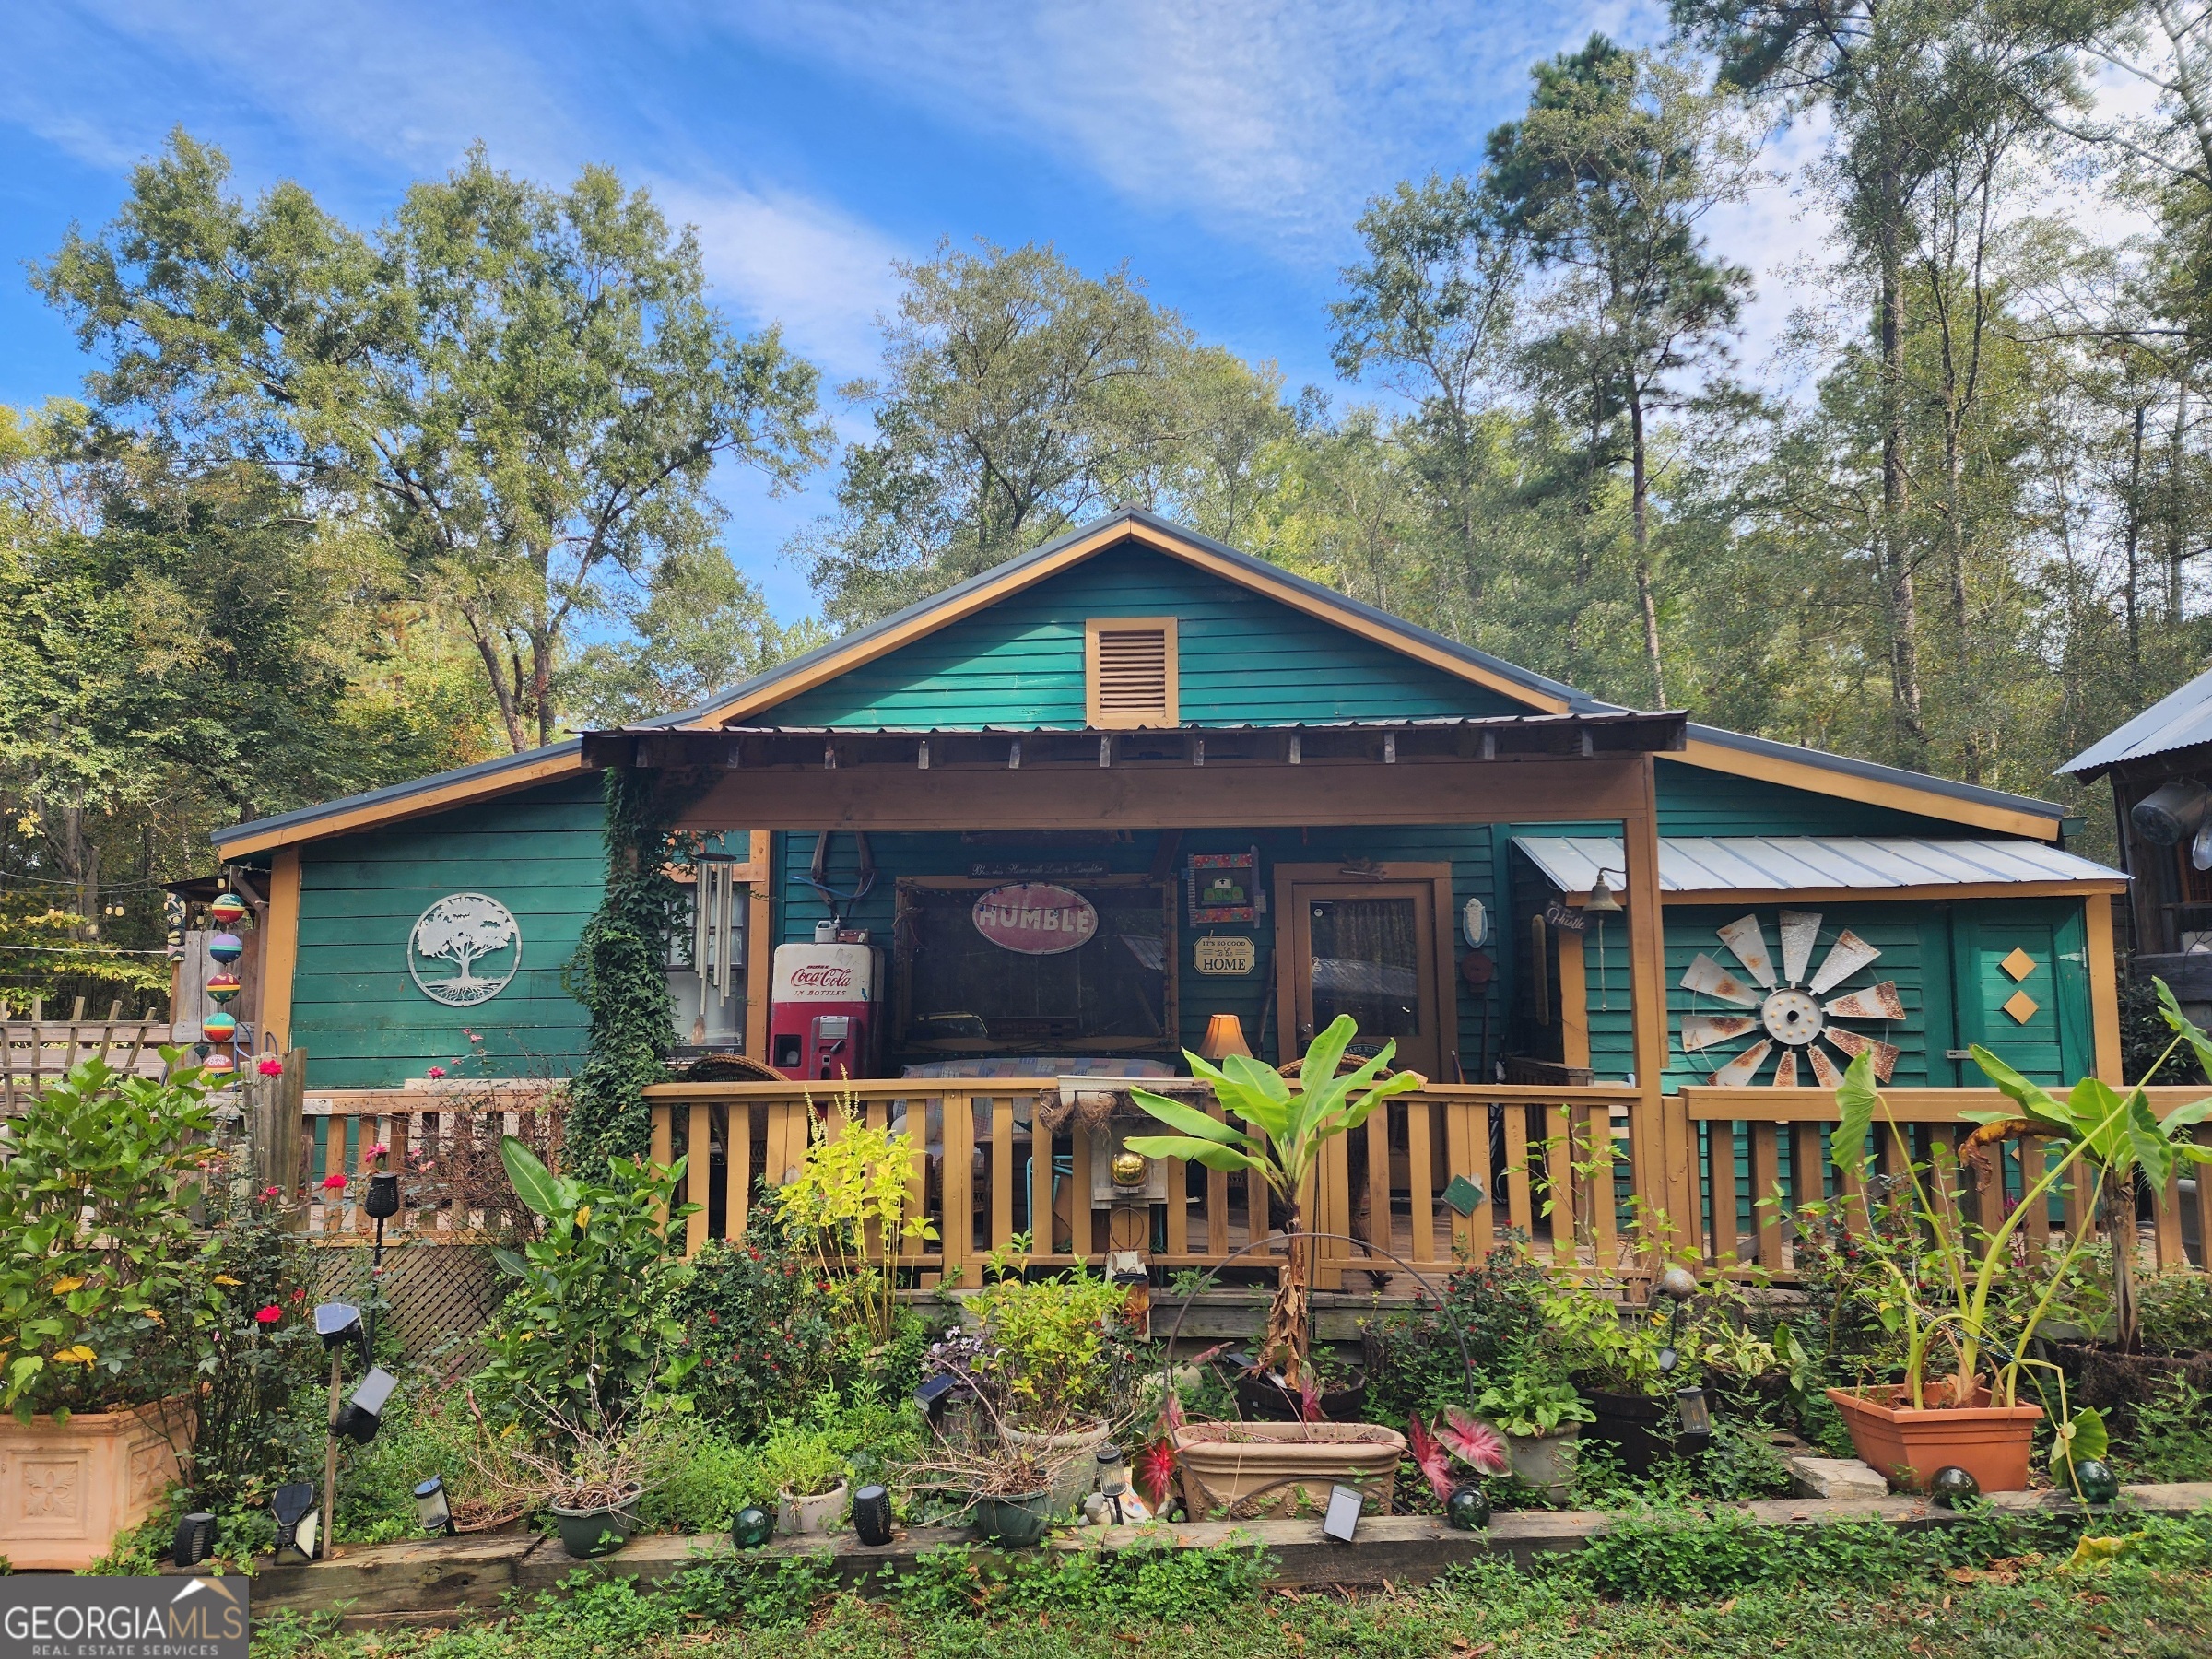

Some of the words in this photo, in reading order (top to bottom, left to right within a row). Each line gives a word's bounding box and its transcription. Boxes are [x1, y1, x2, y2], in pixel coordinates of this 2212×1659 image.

[1030, 864, 1044, 874] with
[979, 903, 1090, 933] HUMBLE
[1547, 907, 1584, 930] Hustle
[1223, 946, 1233, 957] be
[1203, 958, 1246, 971] HOME
